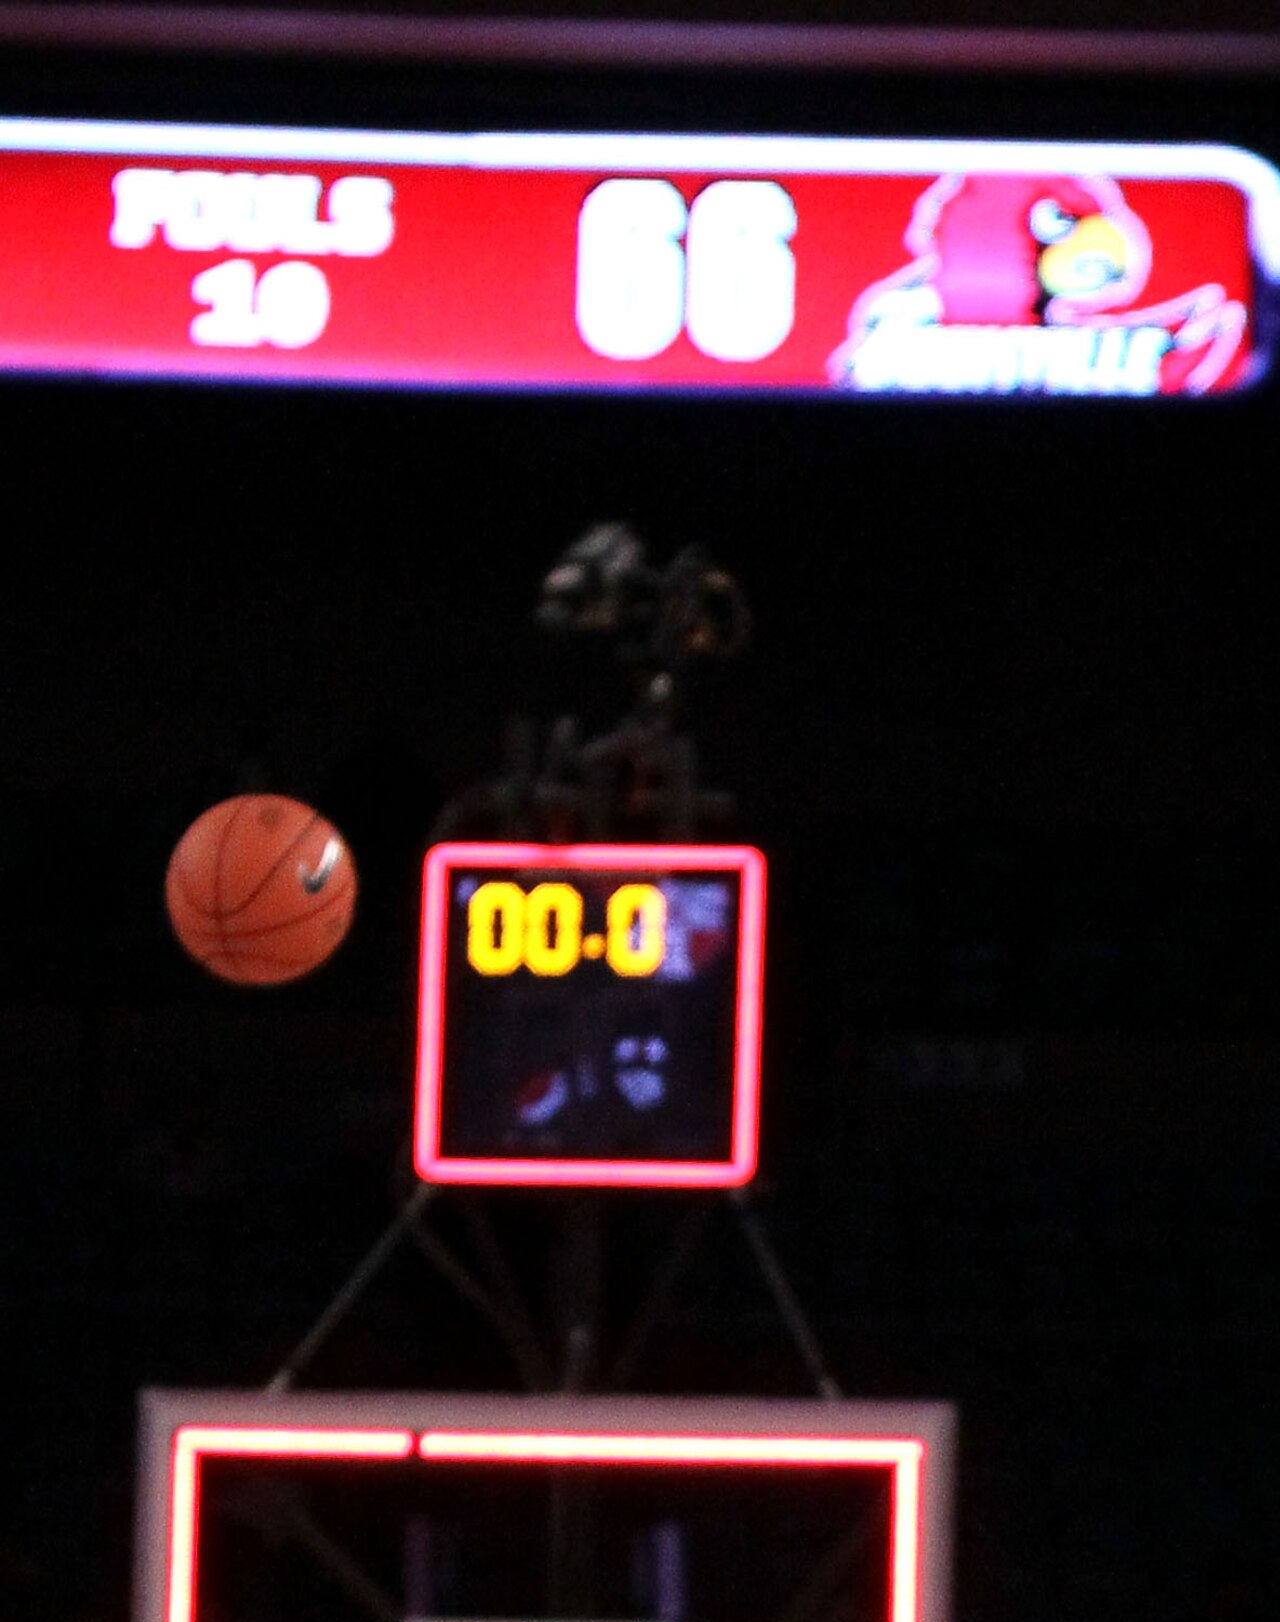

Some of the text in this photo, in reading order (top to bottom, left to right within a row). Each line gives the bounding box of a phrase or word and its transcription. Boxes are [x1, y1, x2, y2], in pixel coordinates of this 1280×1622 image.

[110, 167, 393, 256] FOULS
[189, 259, 330, 349] 10
[577, 177, 797, 361] 66
[467, 881, 667, 976] 00.0
